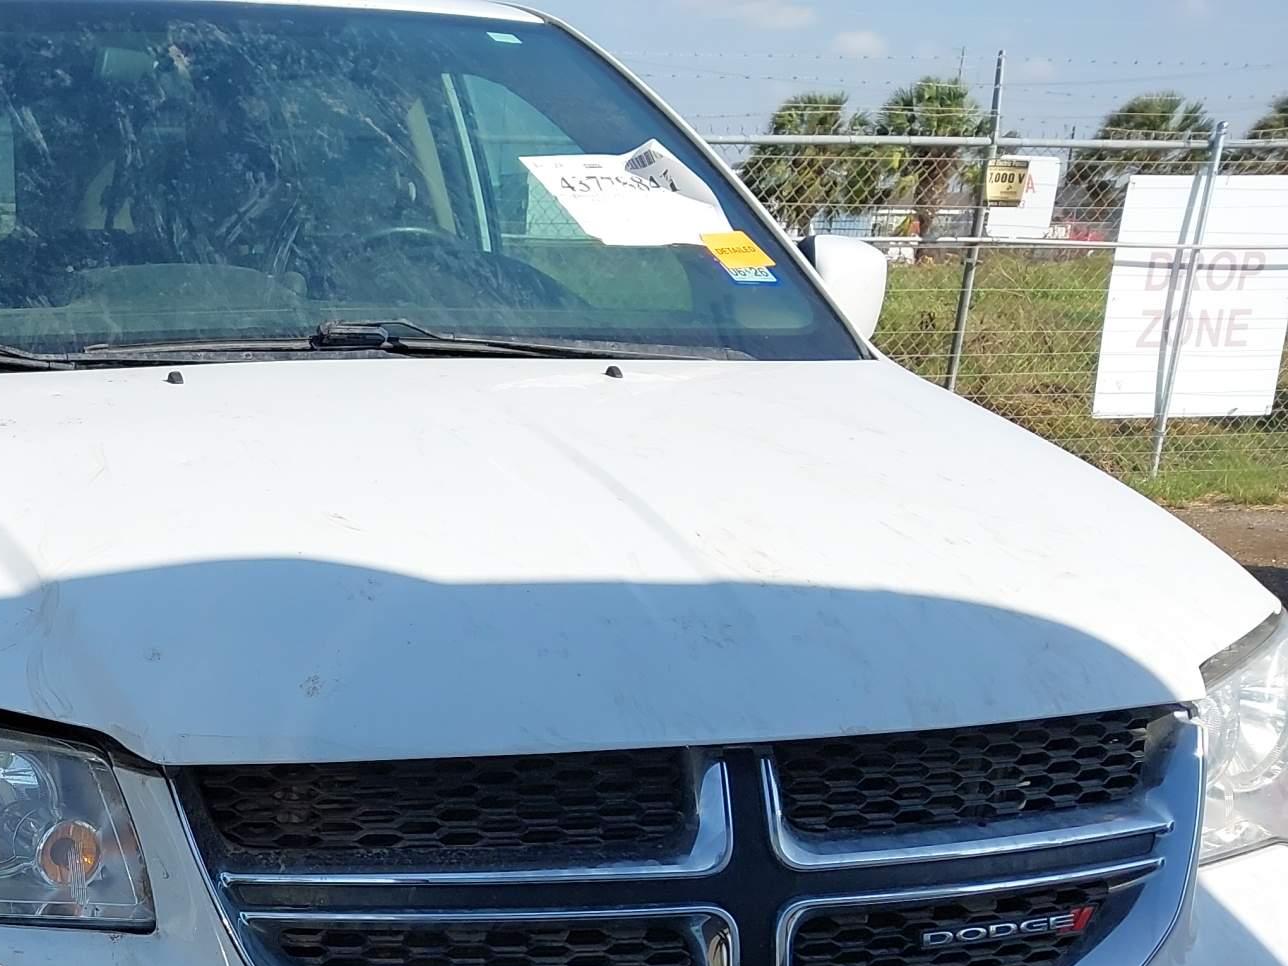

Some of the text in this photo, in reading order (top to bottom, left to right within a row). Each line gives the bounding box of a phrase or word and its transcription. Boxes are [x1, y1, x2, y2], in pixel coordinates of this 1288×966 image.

[1144, 250, 1267, 291] DROP
[1136, 308, 1253, 348] ZONE
[923, 914, 1075, 946] DODGE
